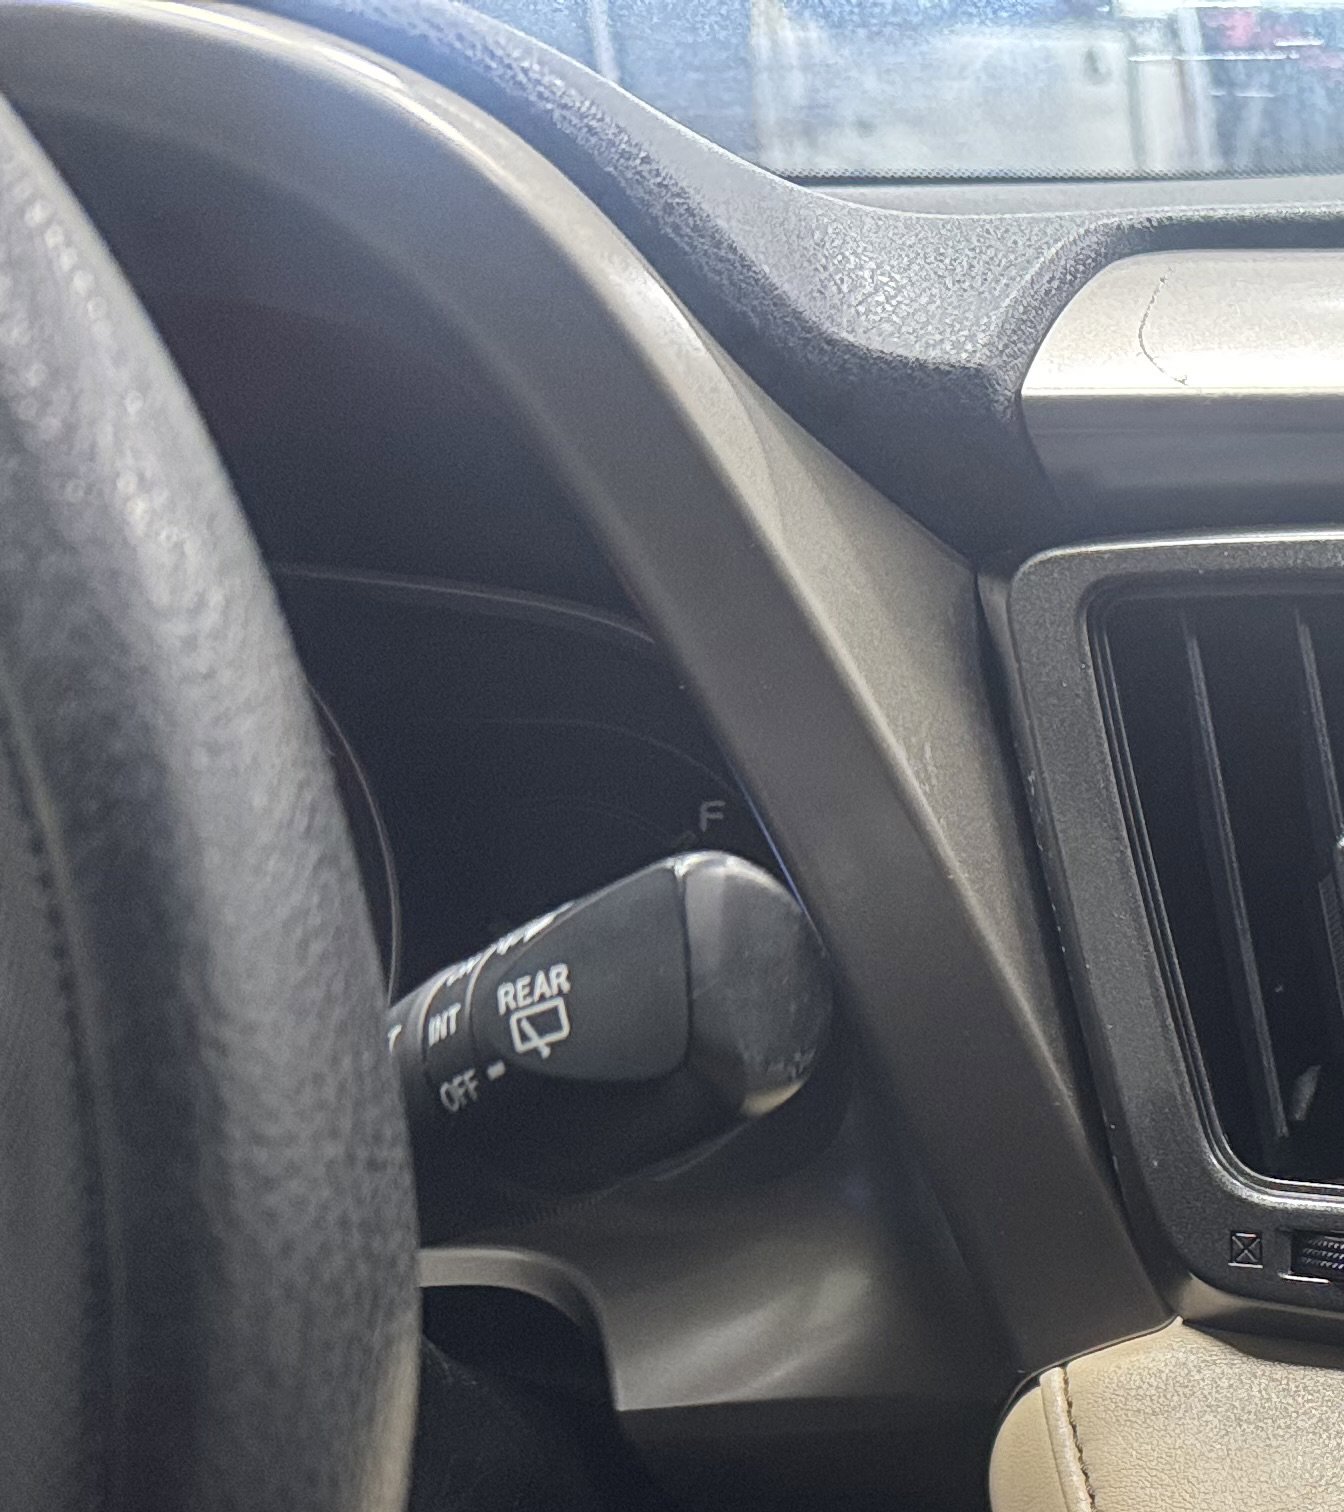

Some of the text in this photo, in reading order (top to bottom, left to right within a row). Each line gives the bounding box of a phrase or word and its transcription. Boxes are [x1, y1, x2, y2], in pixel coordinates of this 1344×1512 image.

[701, 800, 727, 833] F
[496, 962, 572, 1016] REAR
[427, 1002, 462, 1047] INT
[439, 1067, 480, 1112] OFF
